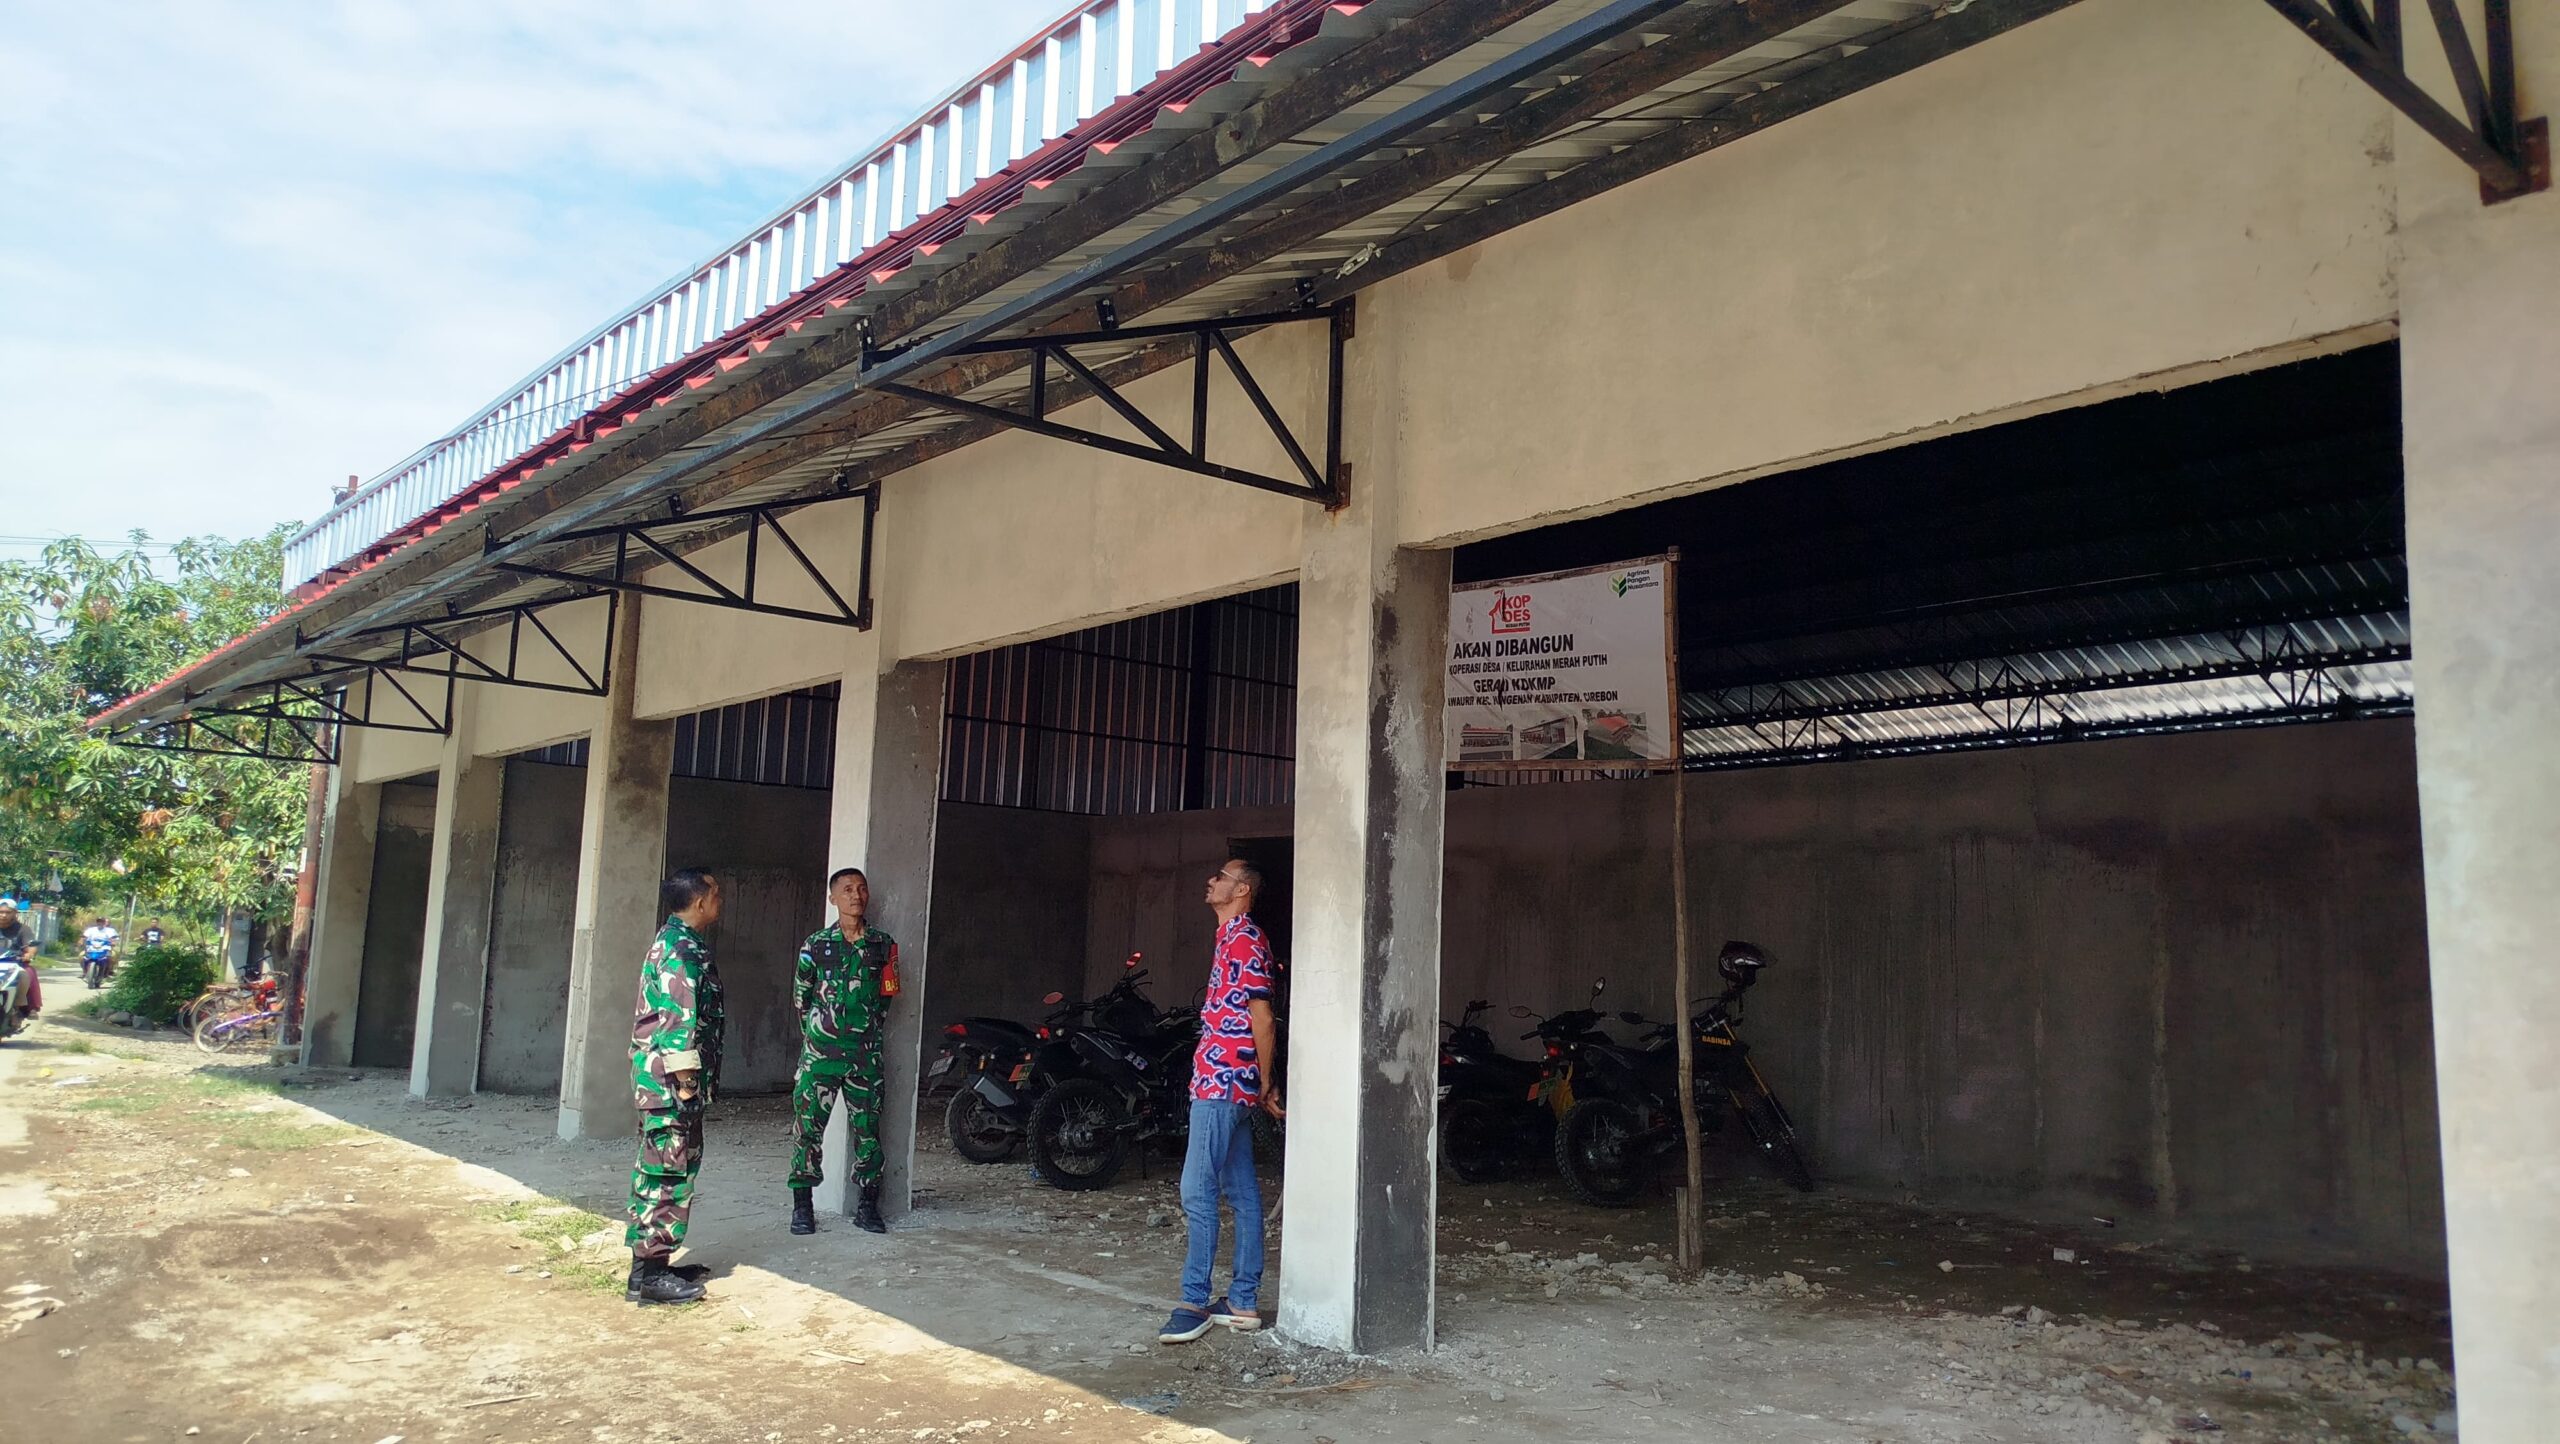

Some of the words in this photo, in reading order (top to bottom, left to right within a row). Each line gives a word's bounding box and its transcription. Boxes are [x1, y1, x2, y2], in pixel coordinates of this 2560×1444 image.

[1627, 569, 1650, 577] Agrinas
[1627, 581, 1659, 590] Nusantara
[1504, 595, 1531, 609] KOP
[1503, 609, 1531, 622] DES
[1453, 641, 1491, 659] AKAN
[1495, 634, 1574, 657] DIBANGUN
[1482, 661, 1501, 673] DESA
[1506, 659, 1551, 672] KELURAHAN
[1552, 656, 1580, 669] MERAH
[1582, 654, 1608, 666] PUTIH
